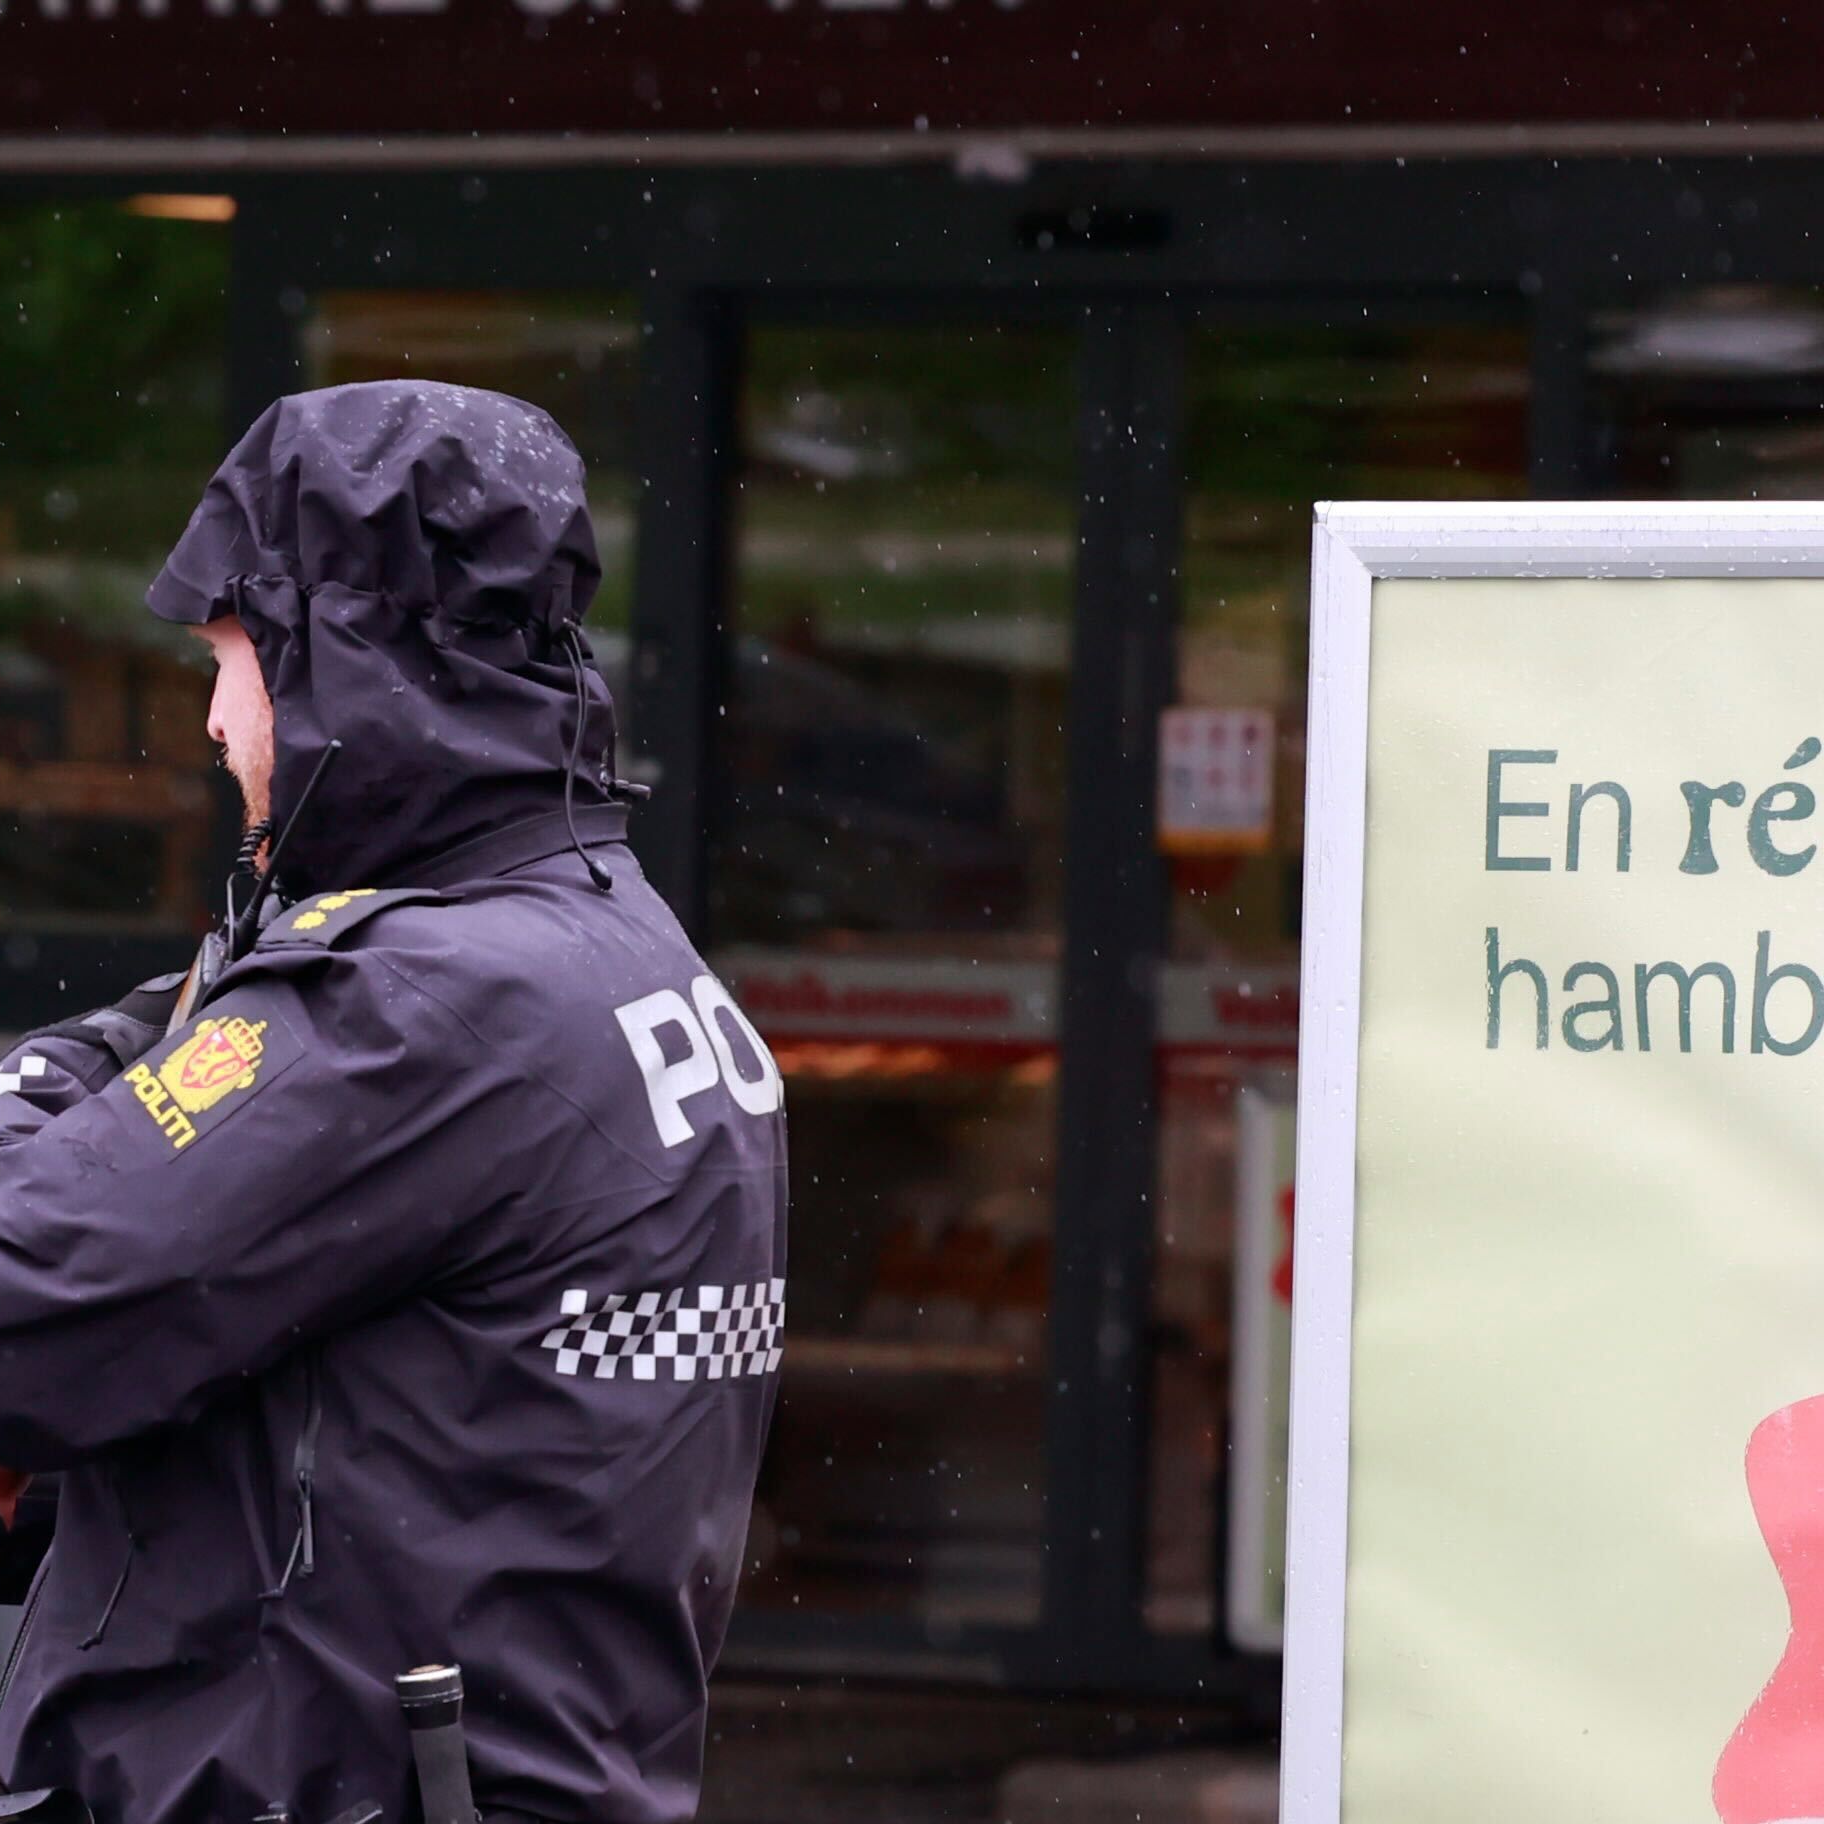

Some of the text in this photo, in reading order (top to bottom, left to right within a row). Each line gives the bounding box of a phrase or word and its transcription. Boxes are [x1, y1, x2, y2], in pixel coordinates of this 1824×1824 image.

[1485, 736, 1822, 877] En ré
[1485, 926, 1824, 1057] hamb
[123, 1063, 197, 1149] POLITI
[614, 974, 784, 1148] PO
